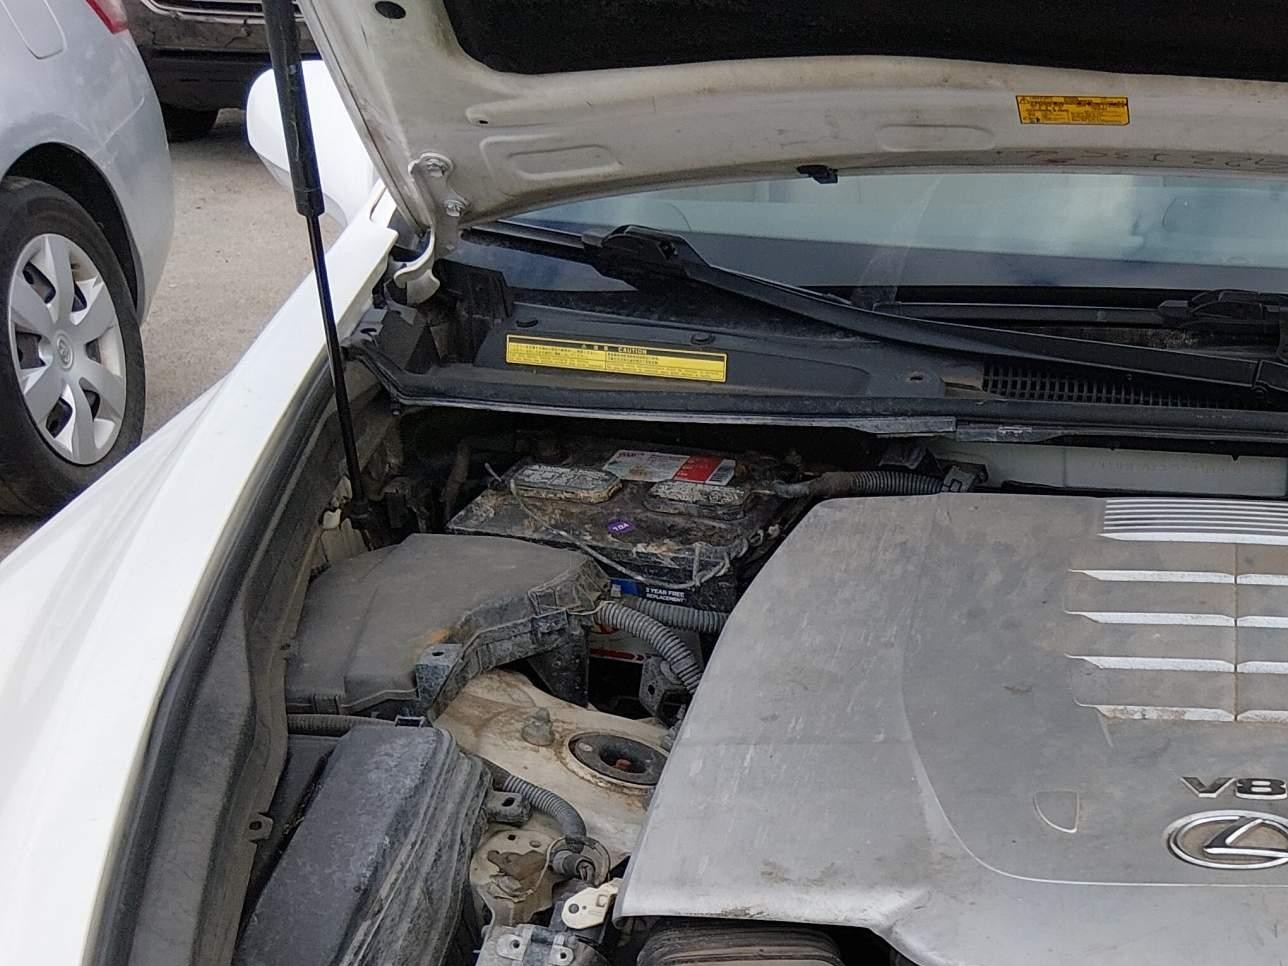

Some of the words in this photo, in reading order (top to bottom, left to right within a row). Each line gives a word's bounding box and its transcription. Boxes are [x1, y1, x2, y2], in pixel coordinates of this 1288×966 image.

[618, 346, 647, 355] CAUTION
[651, 588, 668, 596] YEAR
[668, 590, 685, 598] FREE
[1181, 776, 1287, 800] V8
